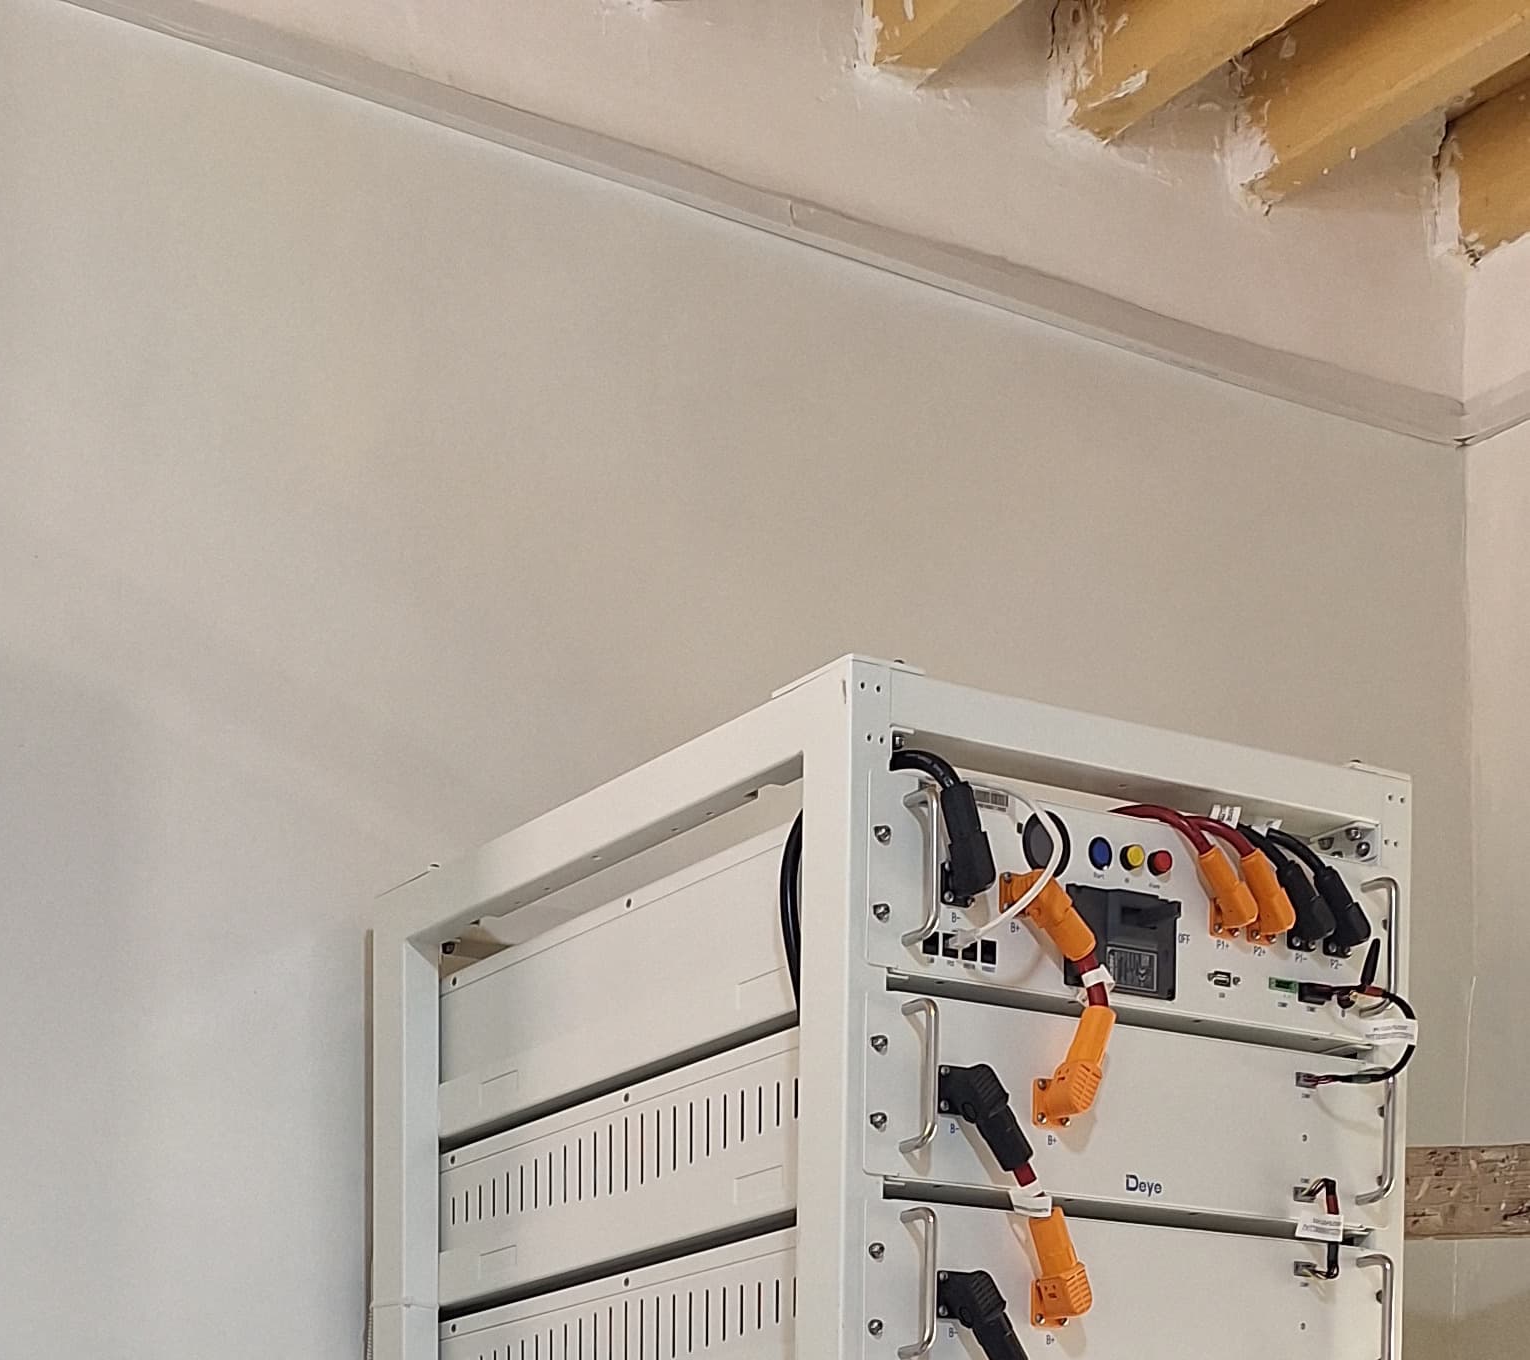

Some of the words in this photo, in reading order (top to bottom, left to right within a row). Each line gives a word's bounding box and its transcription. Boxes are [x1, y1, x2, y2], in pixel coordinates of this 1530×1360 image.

[1010, 922, 1020, 933] B+
[1178, 933, 1190, 945] OFF
[1216, 939, 1228, 950] P1+
[1253, 946, 1266, 957] P2+
[1295, 953, 1307, 963] P1-
[1330, 958, 1342, 969] P2-
[1047, 1135, 1057, 1145] B+
[1125, 1174, 1162, 1197] Deye
